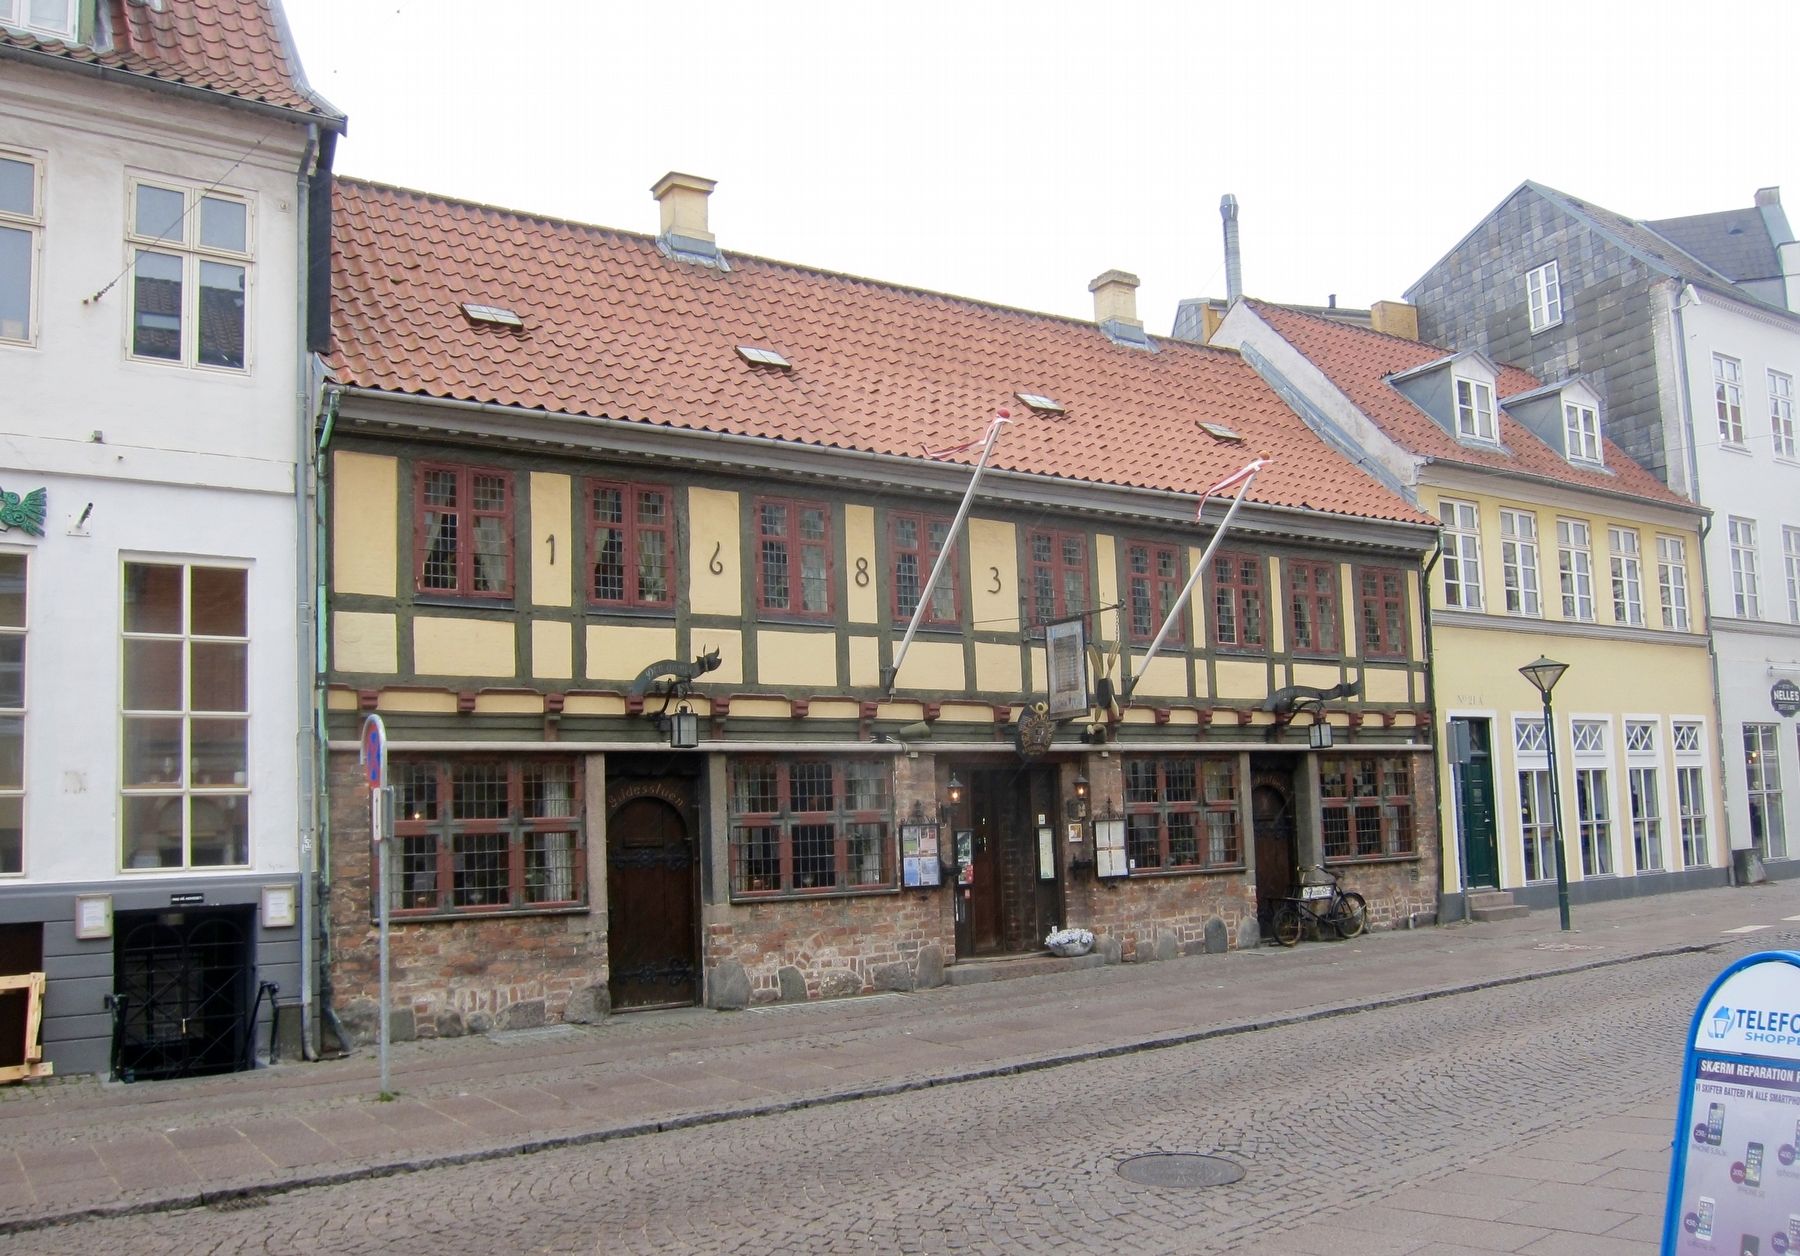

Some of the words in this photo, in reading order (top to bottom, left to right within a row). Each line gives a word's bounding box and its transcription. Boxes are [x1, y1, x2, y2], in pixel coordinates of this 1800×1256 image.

[546, 534, 555, 565] 1
[709, 541, 724, 576] 6
[855, 557, 870, 588] 8
[988, 566, 1002, 595] 3
[1701, 1060, 1734, 1075] SKÆRM
[1737, 1064, 1793, 1082] REPARATION
[1701, 1084, 1723, 1095] SKIFTER
[1724, 1087, 1746, 1098] BATTERI
[1755, 1091, 1768, 1101] ALLE
